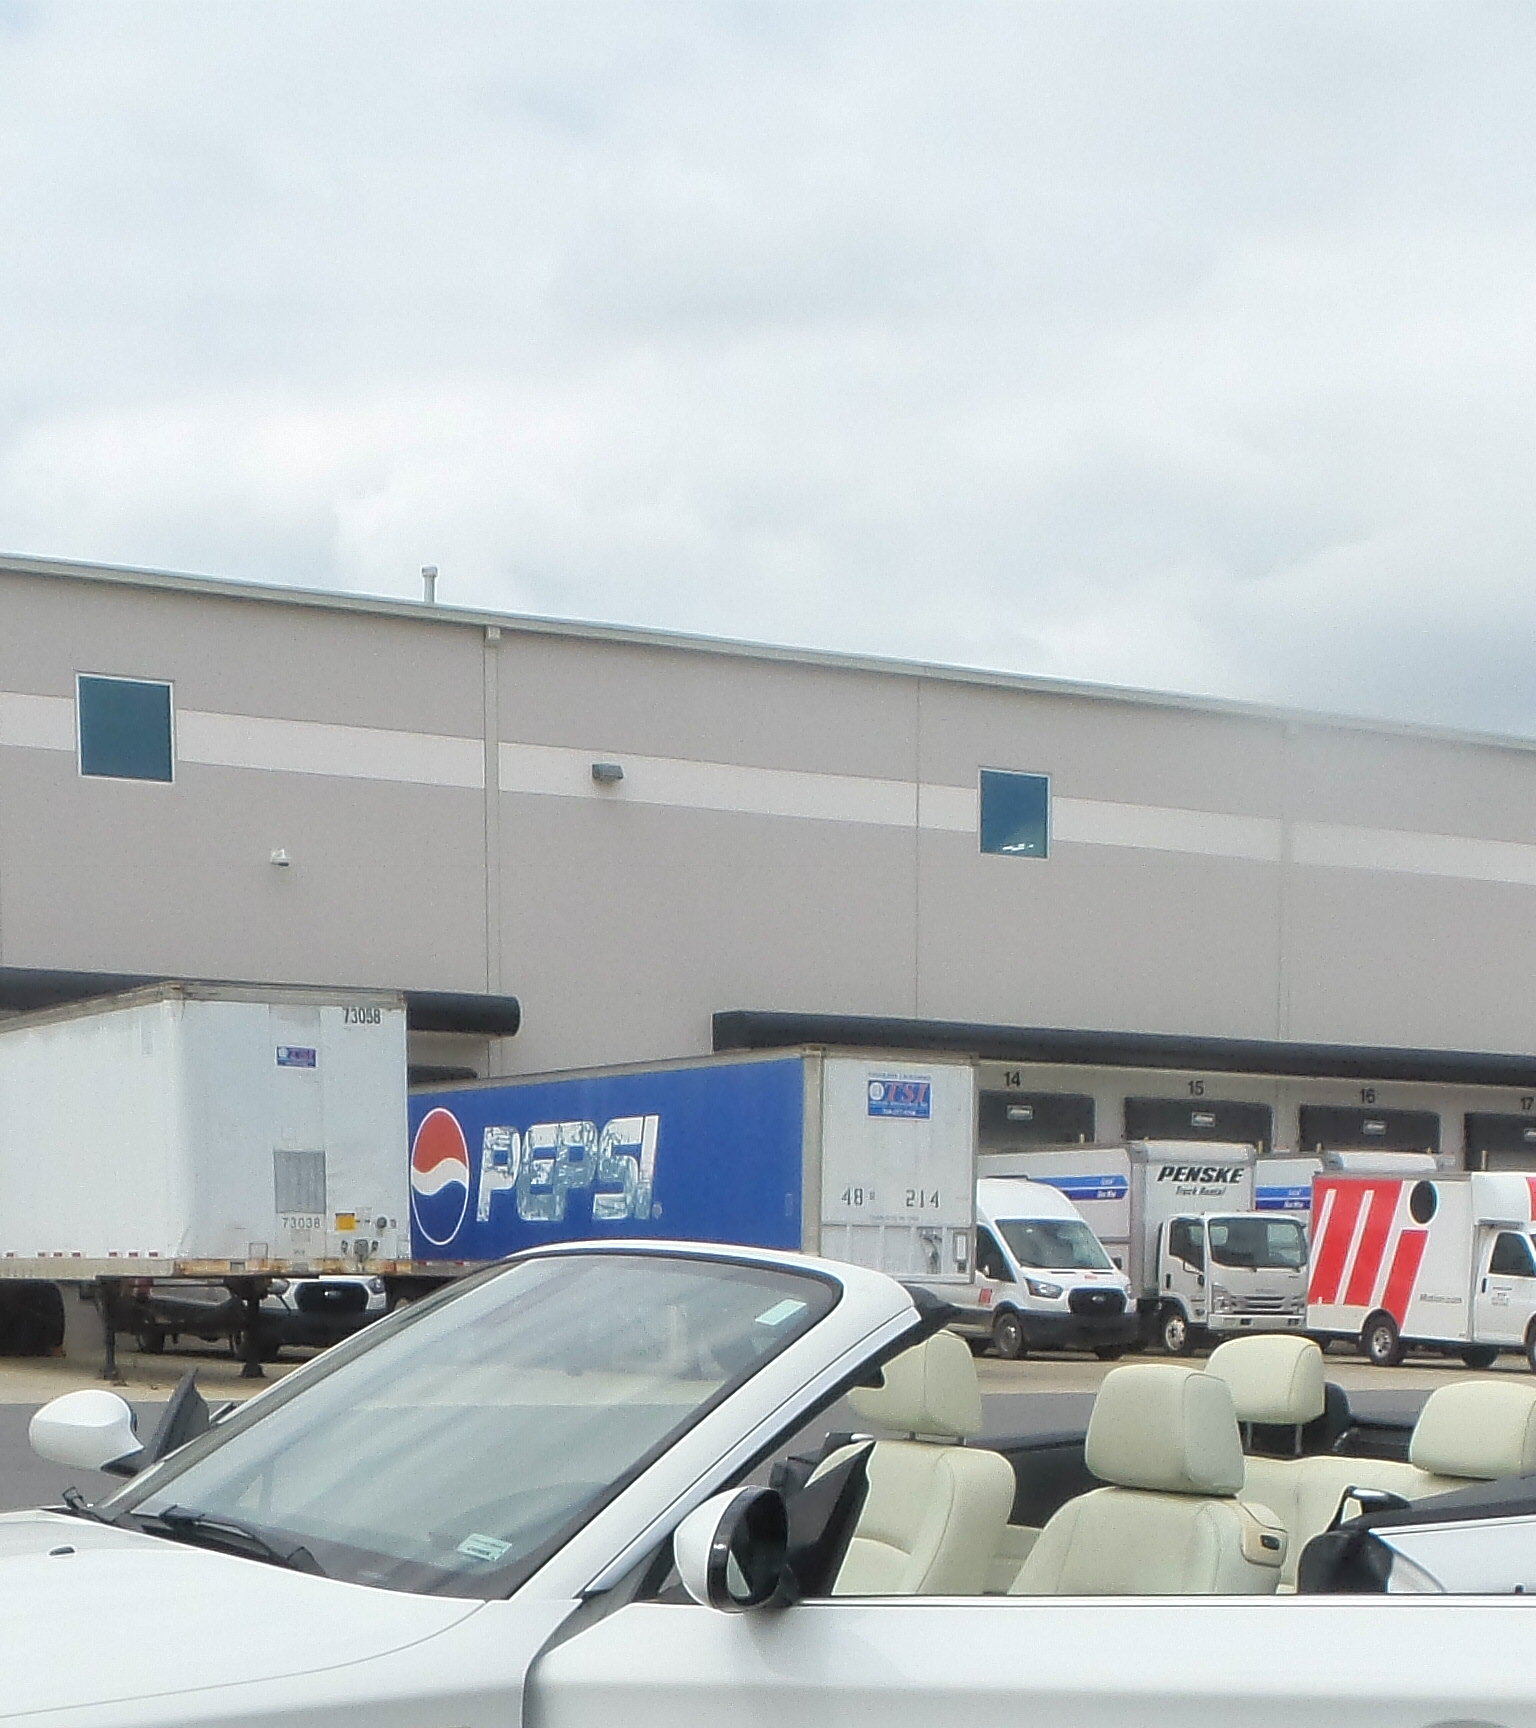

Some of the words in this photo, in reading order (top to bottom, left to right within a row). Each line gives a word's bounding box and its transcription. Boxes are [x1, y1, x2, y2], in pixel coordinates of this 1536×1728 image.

[1004, 1071, 1021, 1087] 14
[1188, 1080, 1204, 1096] 15
[1360, 1088, 1376, 1104] 16
[1520, 1096, 1534, 1111] 17
[476, 1114, 660, 1222] PEPSI
[1156, 1166, 1244, 1184] PENSKE
[841, 1187, 864, 1206] 48
[905, 1189, 939, 1208] 214
